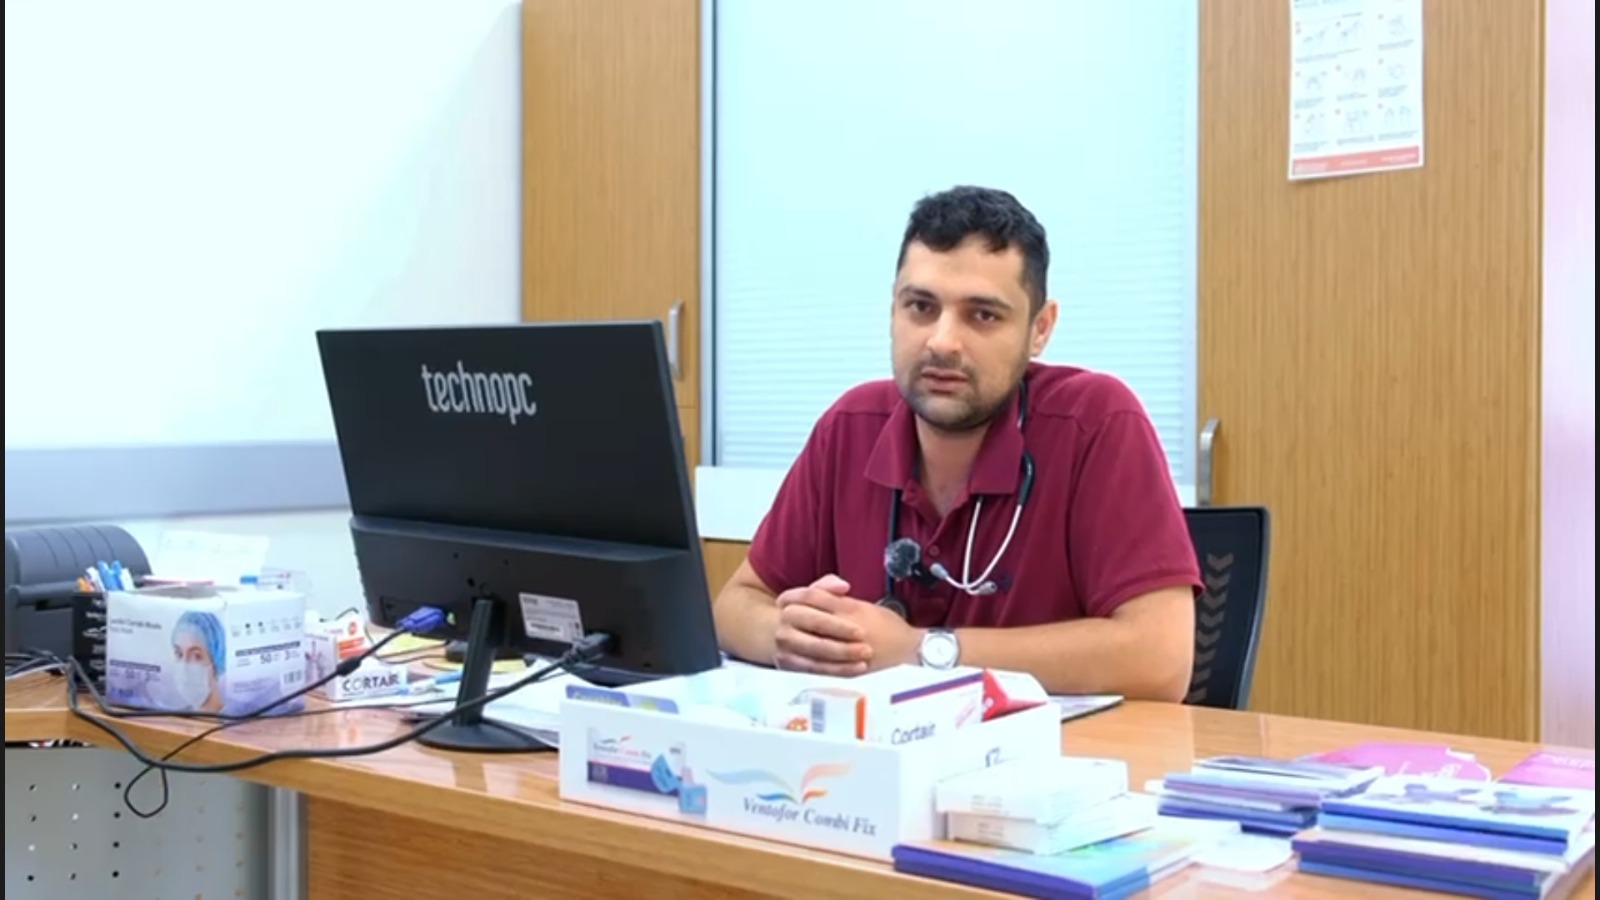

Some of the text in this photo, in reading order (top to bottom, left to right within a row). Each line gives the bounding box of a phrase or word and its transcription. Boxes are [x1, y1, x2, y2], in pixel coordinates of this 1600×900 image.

[421, 360, 536, 425] technopc
[342, 673, 400, 692] CORTAIR
[743, 797, 877, 836] Ventofor Combi Fix
